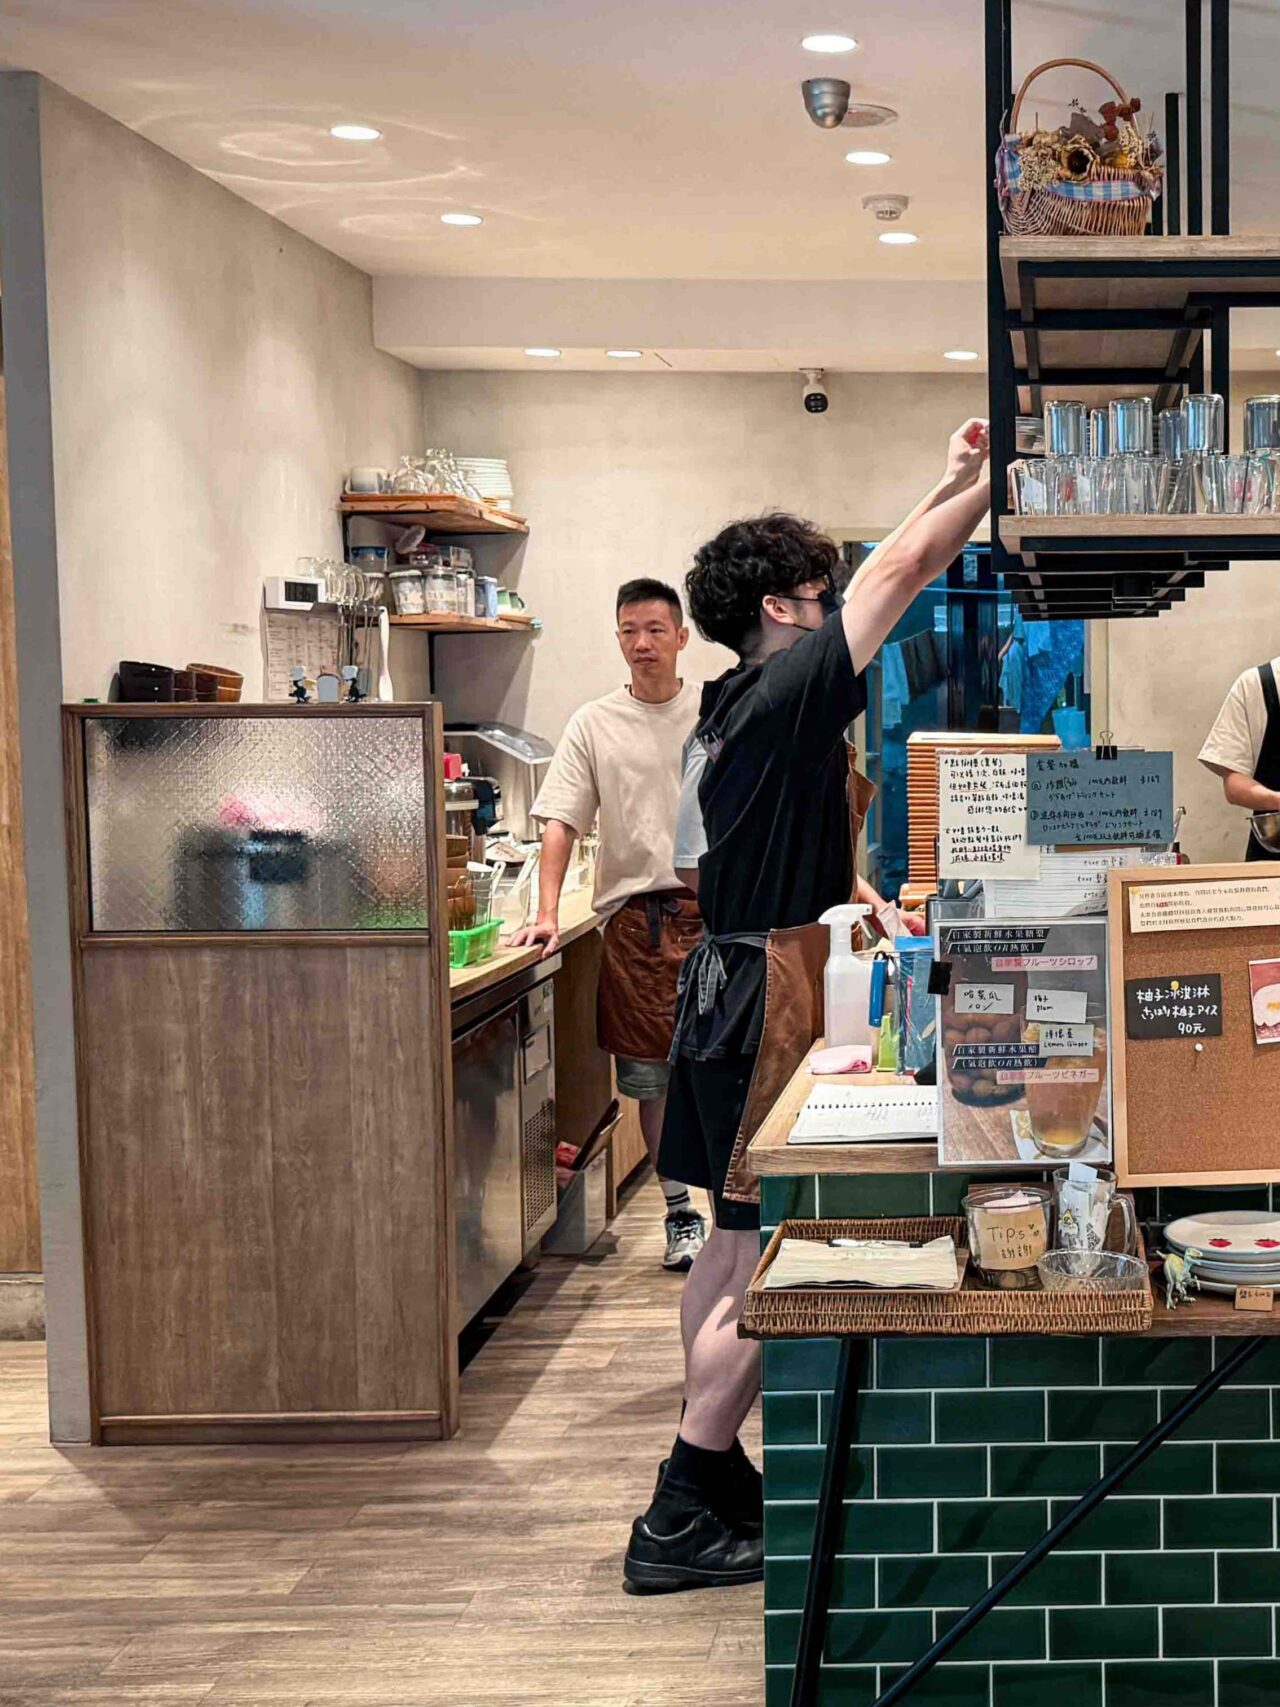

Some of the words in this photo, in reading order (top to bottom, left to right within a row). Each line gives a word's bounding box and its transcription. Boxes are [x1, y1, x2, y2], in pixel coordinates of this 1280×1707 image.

[1136, 984, 1211, 1004] 柚子冰淇淋
[1178, 1021, 1206, 1035] 90元
